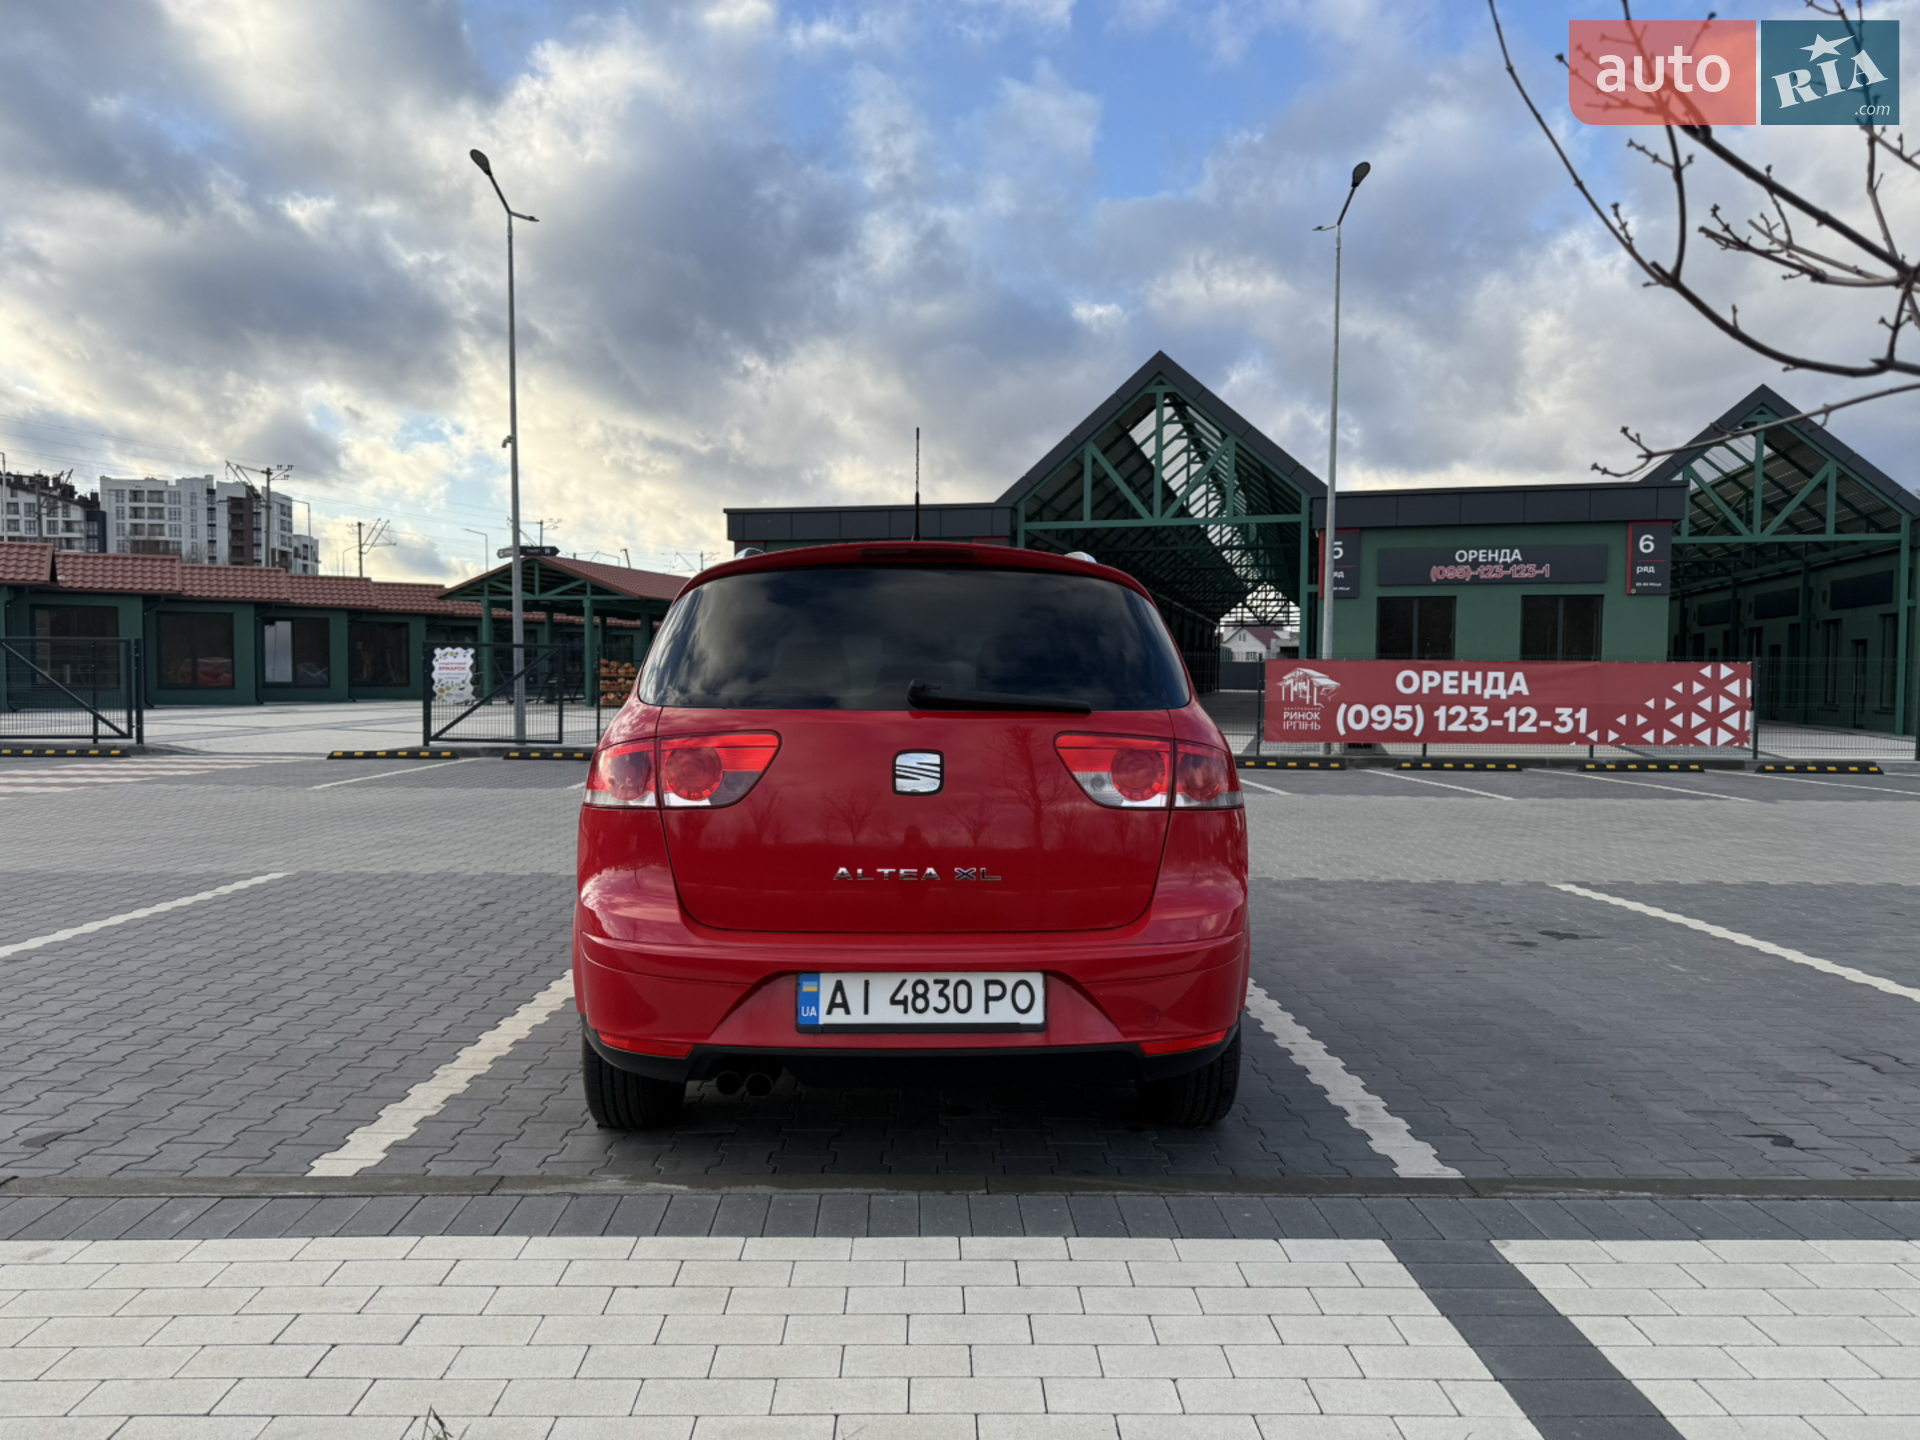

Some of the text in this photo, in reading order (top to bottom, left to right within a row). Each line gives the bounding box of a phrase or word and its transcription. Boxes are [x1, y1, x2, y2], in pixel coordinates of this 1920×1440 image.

[1639, 534, 1655, 554] 6
[1455, 549, 1522, 564] ОРЕНДА
[1636, 566, 1655, 574] ряд
[1395, 669, 1530, 699] ОРЕНДА
[1283, 711, 1321, 720] РИНОК
[1336, 702, 1588, 737] (095) 123-12-31
[1283, 721, 1321, 730] ІРПІНЬ
[833, 867, 1002, 881] ALTEA XL
[825, 979, 1036, 1015] AI 4830 PO
[801, 1006, 818, 1017] UA
